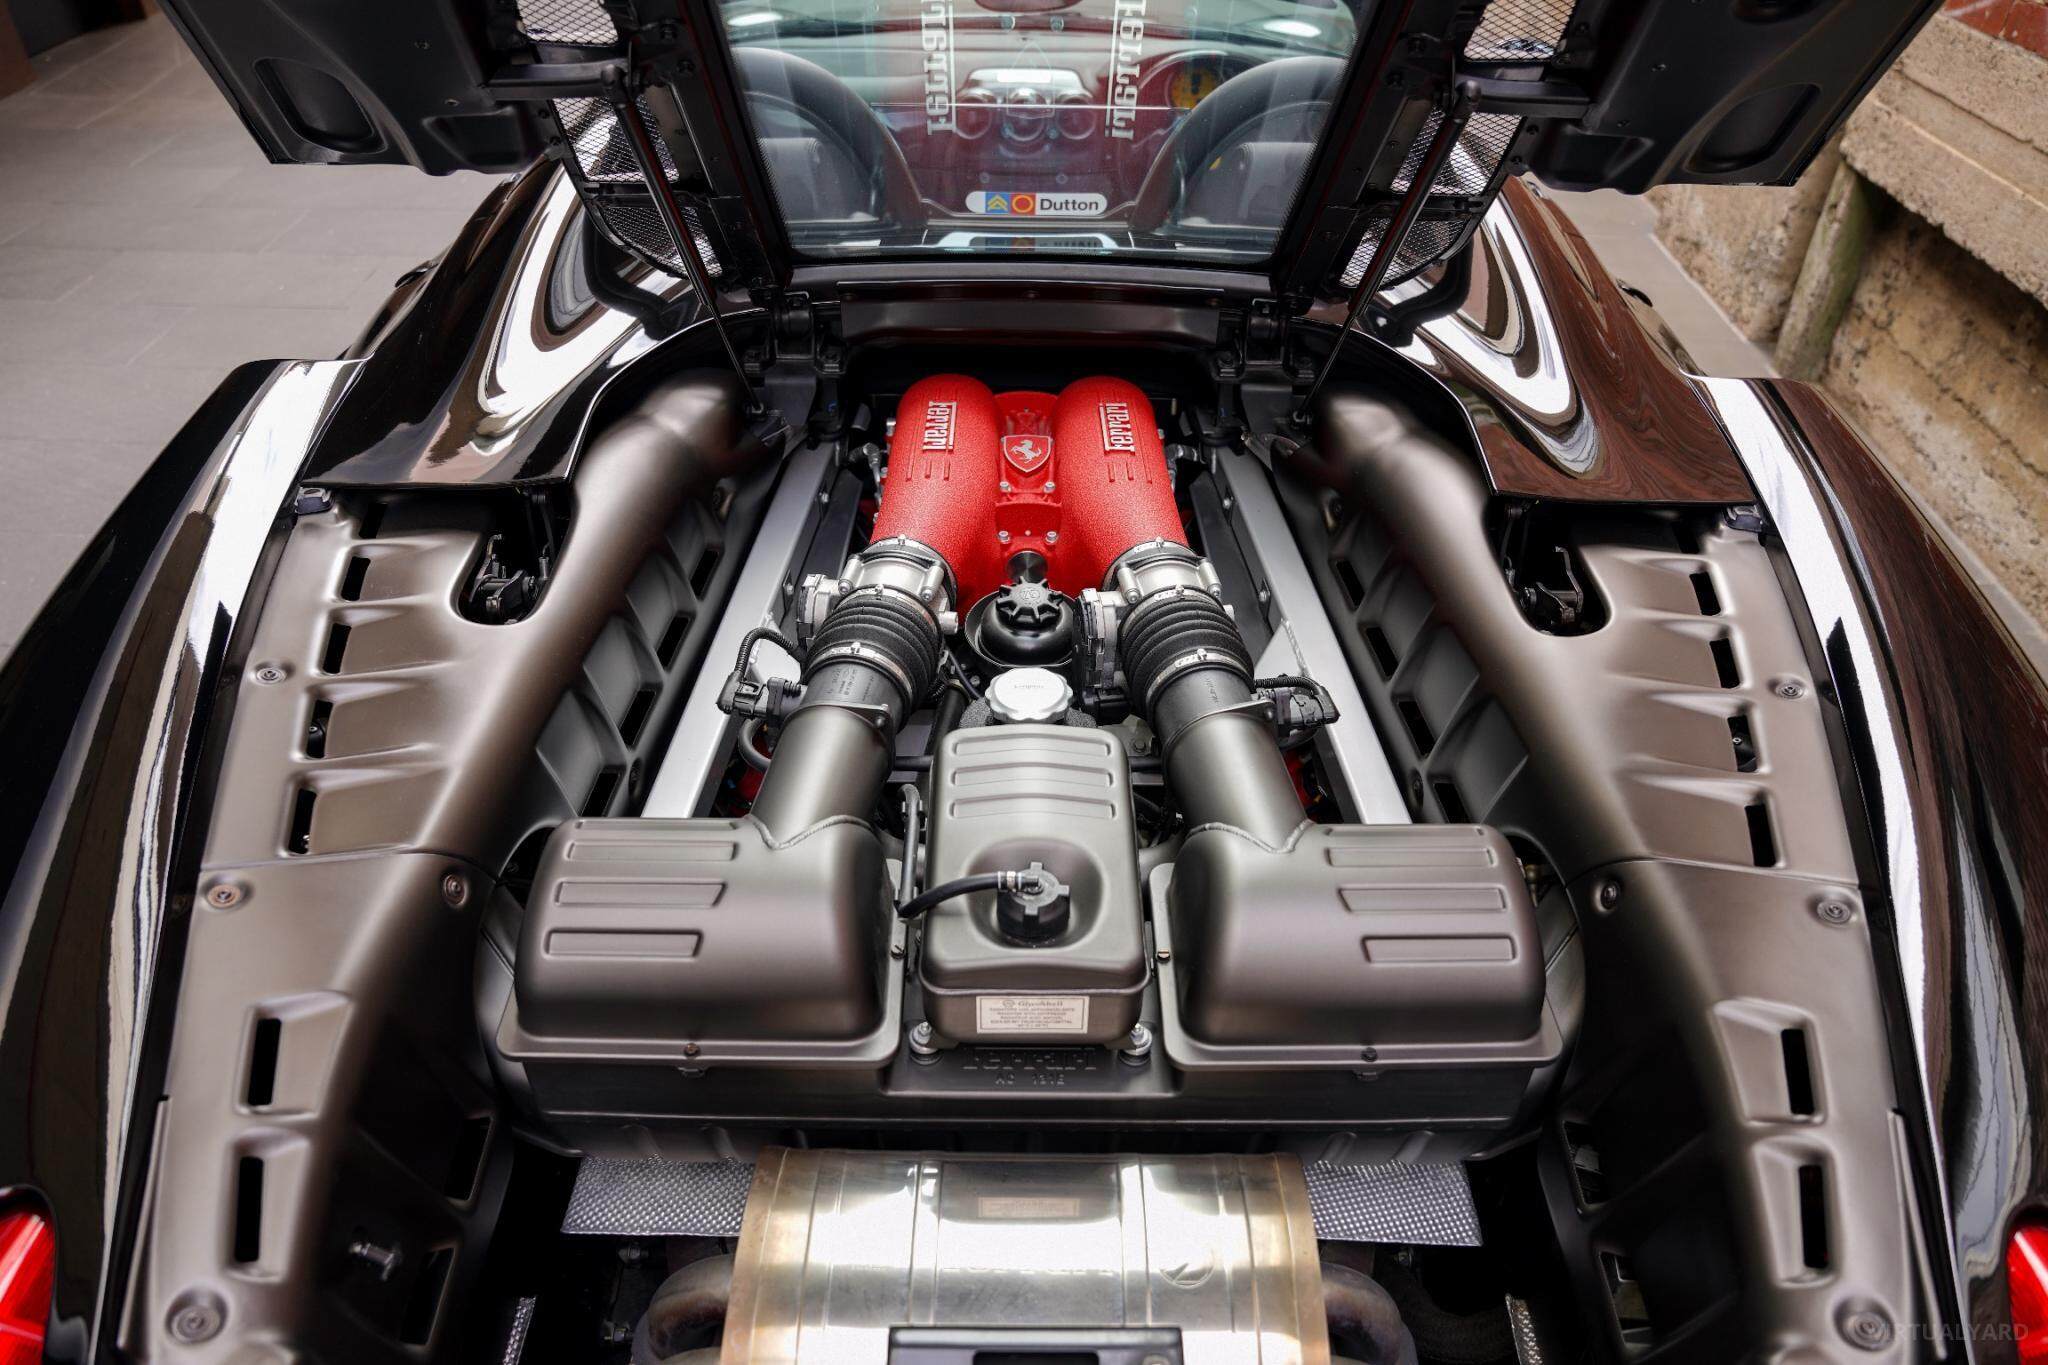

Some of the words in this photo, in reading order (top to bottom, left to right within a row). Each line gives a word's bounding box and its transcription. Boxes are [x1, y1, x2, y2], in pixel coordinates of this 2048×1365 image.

[1040, 198, 1099, 212] Dutton
[922, 401, 957, 450] Ferrari
[1099, 402, 1136, 452] Ferrari
